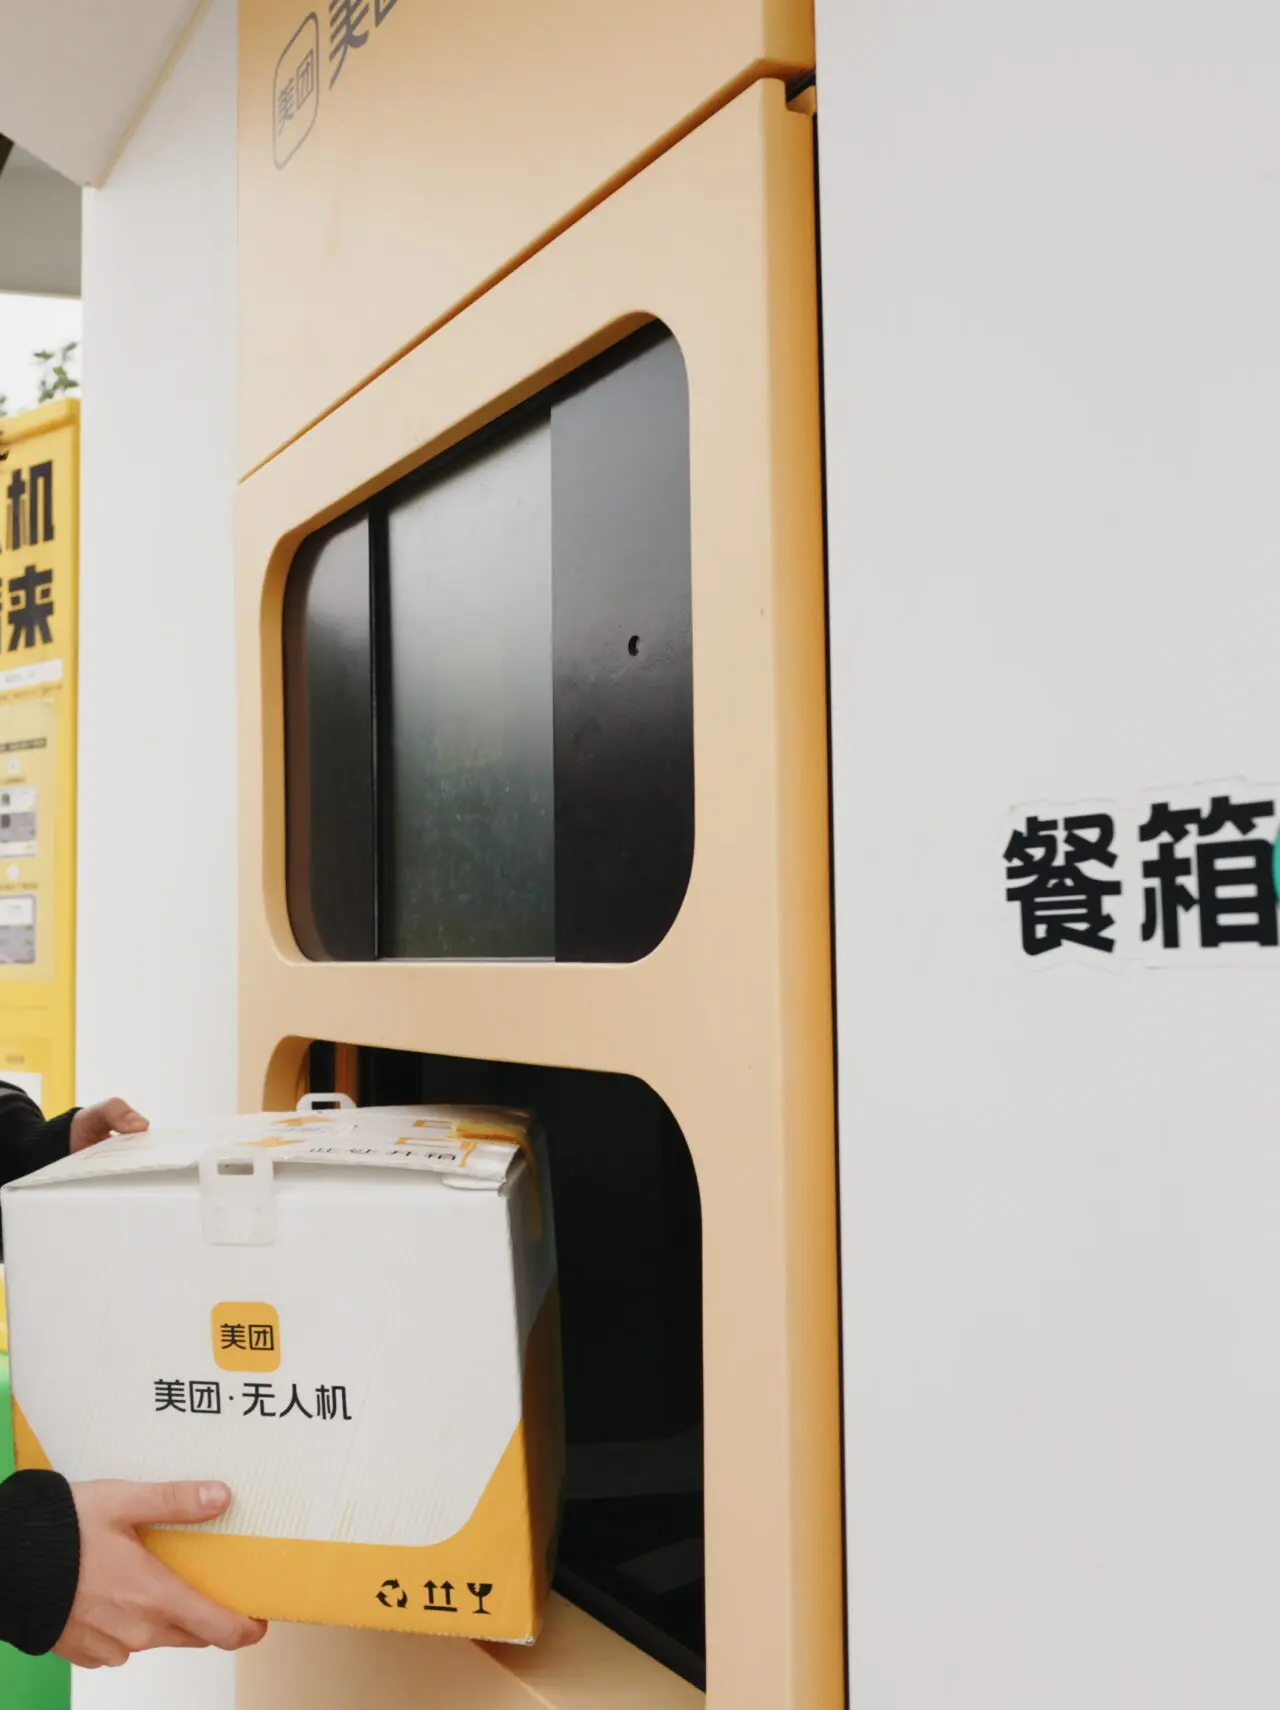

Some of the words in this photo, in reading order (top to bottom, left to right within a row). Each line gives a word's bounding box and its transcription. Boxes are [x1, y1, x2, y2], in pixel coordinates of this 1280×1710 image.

[277, 48, 314, 138] 美团
[1003, 795, 1279, 956] 餐箱
[220, 1323, 274, 1351] 美团
[154, 1379, 352, 1420] 美团·无人机
